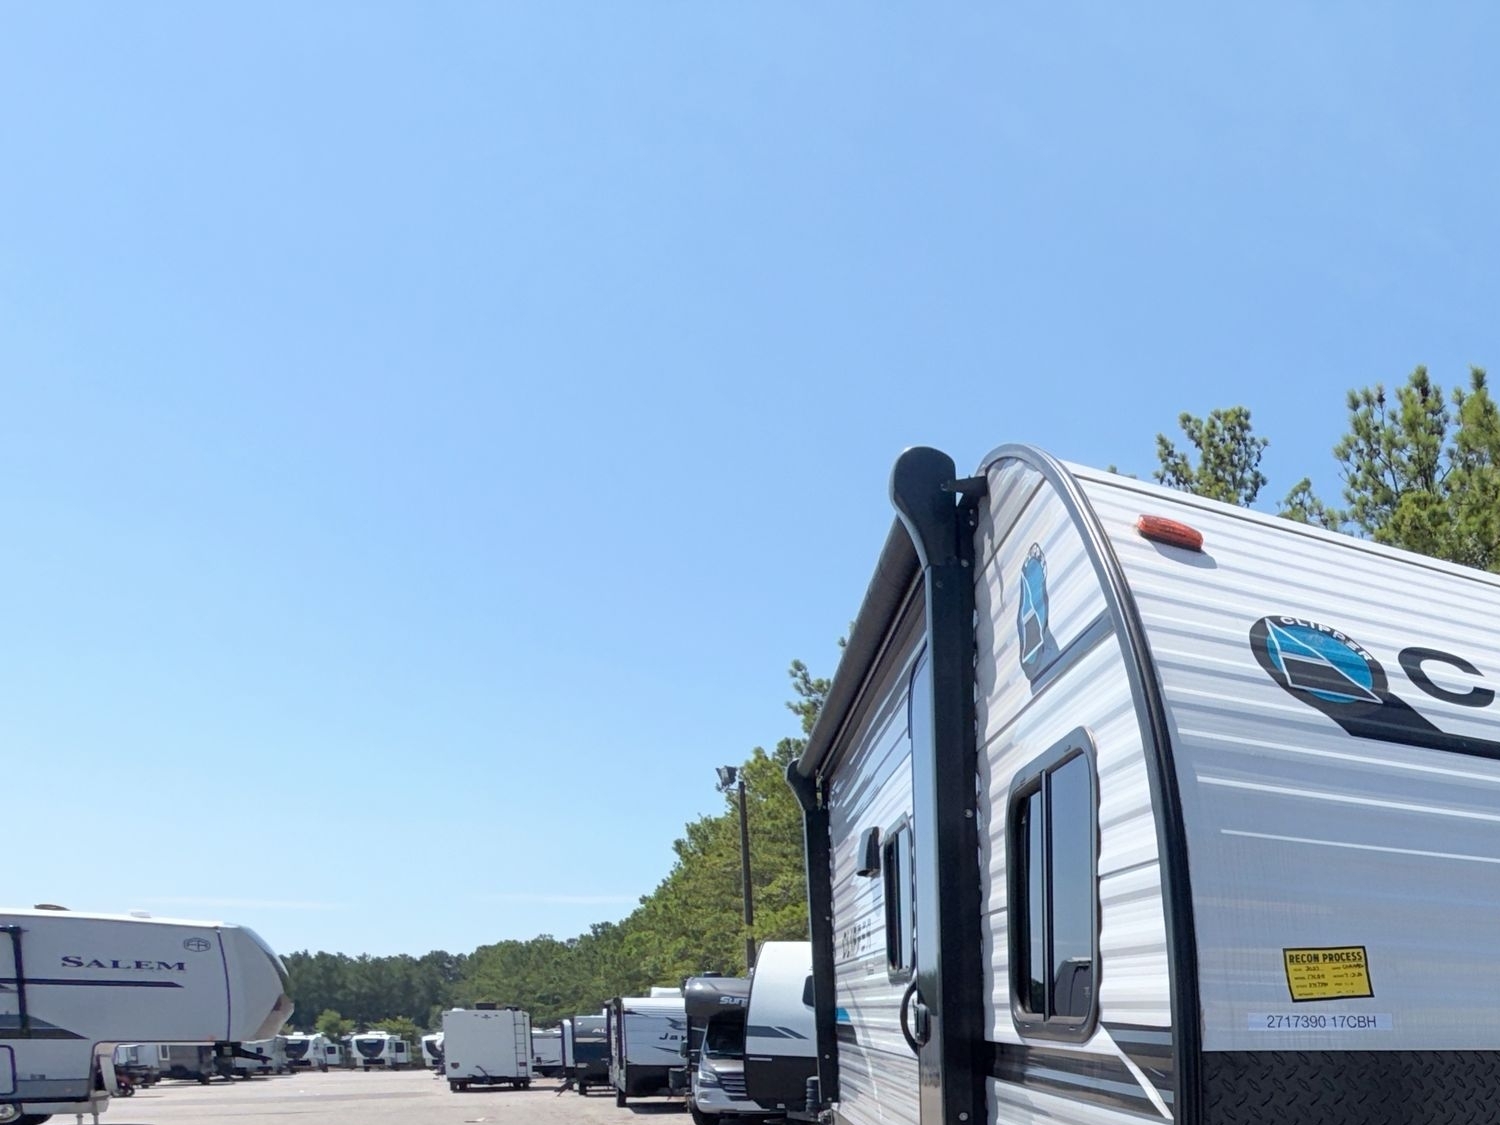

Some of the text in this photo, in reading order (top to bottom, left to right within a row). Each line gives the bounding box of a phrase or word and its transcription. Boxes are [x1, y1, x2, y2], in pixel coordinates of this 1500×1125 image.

[1280, 616, 1373, 661] CLIPPER
[61, 955, 187, 971] SALEM
[1288, 951, 1363, 964] RECON PROCESS
[1266, 1014, 1377, 1029] 2717390 17CBH
